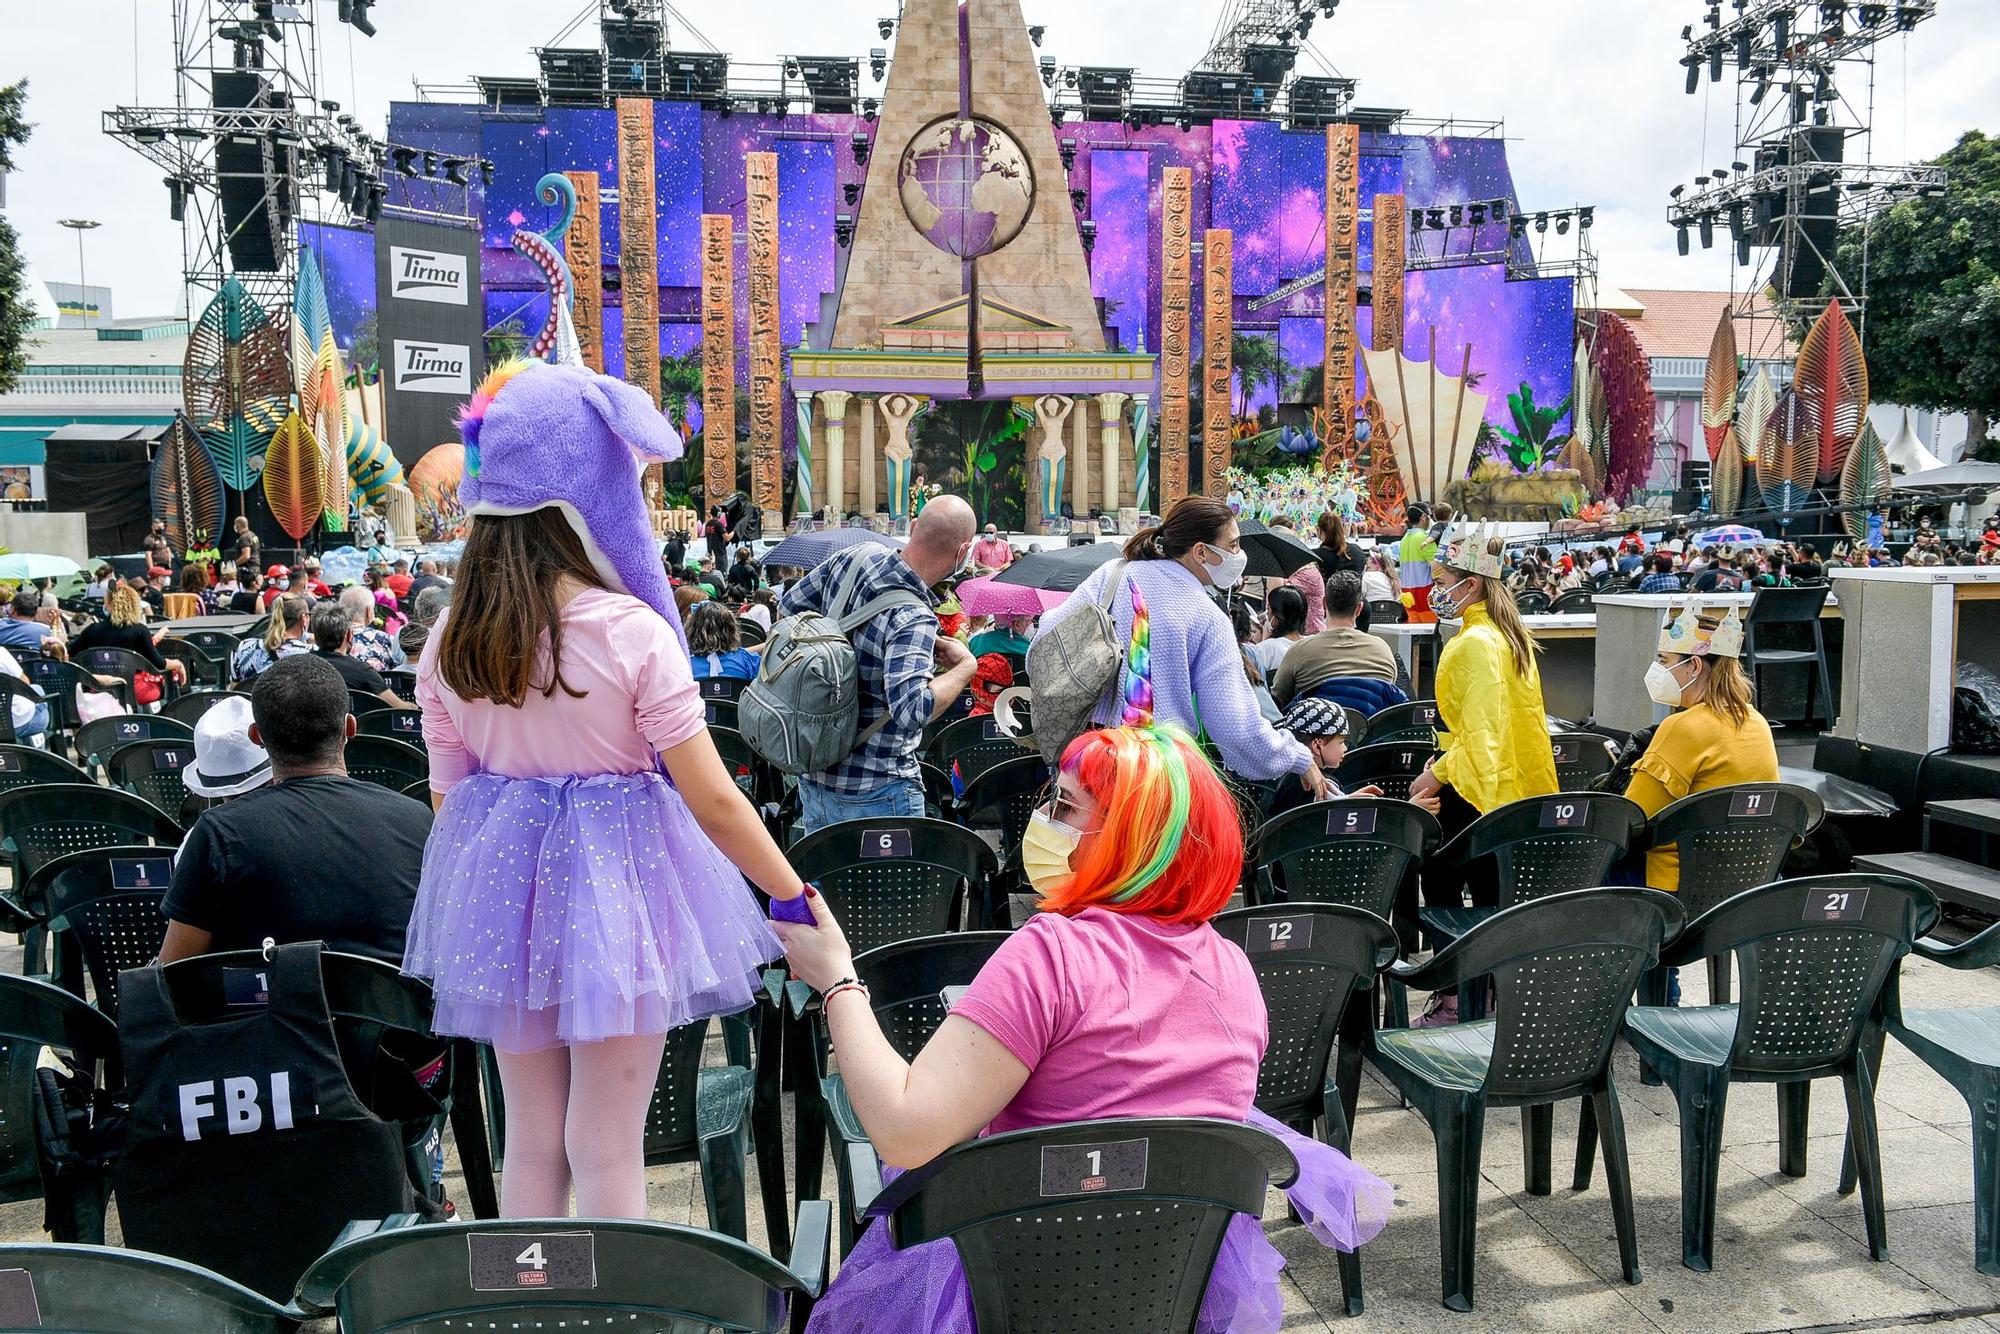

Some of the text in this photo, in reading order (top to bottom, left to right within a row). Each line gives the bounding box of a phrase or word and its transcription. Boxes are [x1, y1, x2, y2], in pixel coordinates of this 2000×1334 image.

[401, 252, 460, 283] Tirma
[404, 345, 463, 373] Tirma
[713, 683, 721, 692] 8
[965, 697, 972, 706] 6
[1423, 709, 1435, 718] 13
[123, 723, 140, 733] 20
[401, 716, 414, 727] 14
[165, 752, 178, 763] 11
[1401, 752, 1412, 764] 11
[1748, 794, 1761, 808] 11
[1555, 804, 1574, 819] 10
[1345, 812, 1358, 826] 5
[879, 834, 892, 849] 6
[136, 864, 146, 878] 1
[1824, 893, 1849, 911] 21
[1268, 922, 1292, 941] 12
[179, 1072, 294, 1142] FBI
[1086, 1150, 1101, 1176] 1
[516, 1243, 547, 1269] 4
